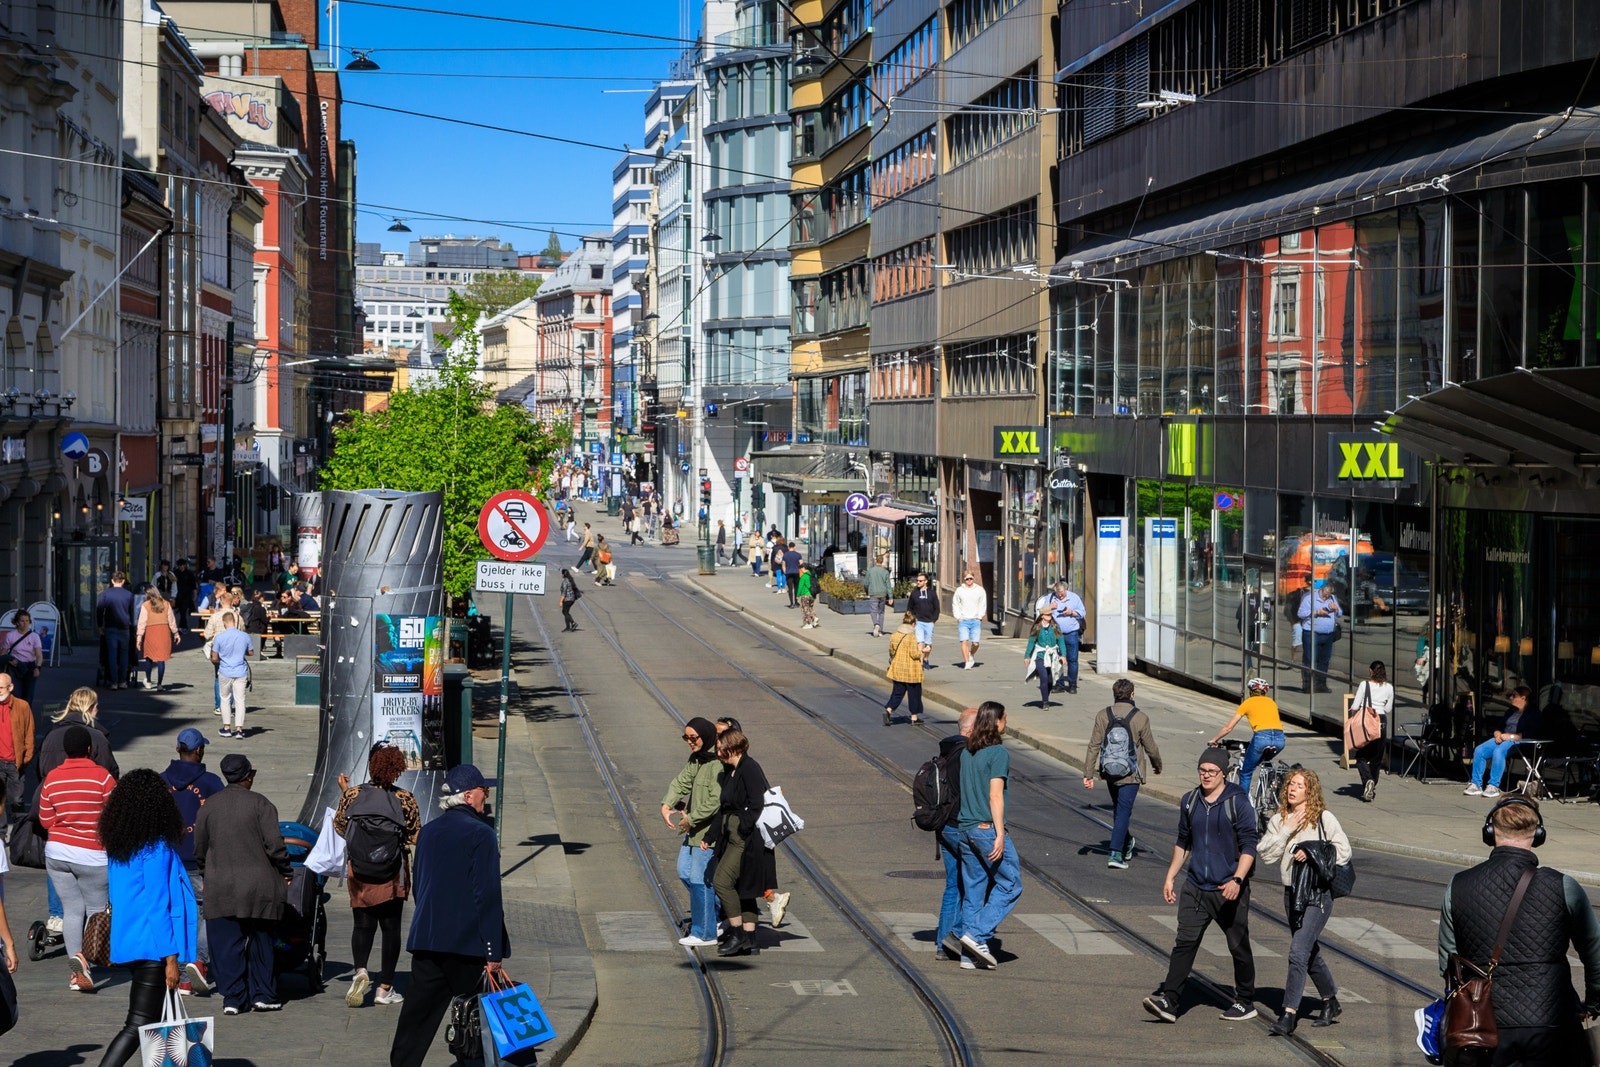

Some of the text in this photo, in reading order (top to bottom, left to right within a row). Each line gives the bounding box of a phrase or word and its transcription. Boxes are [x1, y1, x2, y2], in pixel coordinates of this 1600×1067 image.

[320, 135, 328, 178] COLLECTION
[1000, 431, 1041, 454] XXL
[1338, 442, 1405, 480] XXL
[906, 516, 938, 526] basso
[481, 564, 542, 577] Gjelder ikke
[481, 579, 540, 591] buss i rute
[400, 618, 425, 639] 50
[383, 696, 419, 707] DRIVE-BY
[381, 706, 421, 716] TRUCKERS
